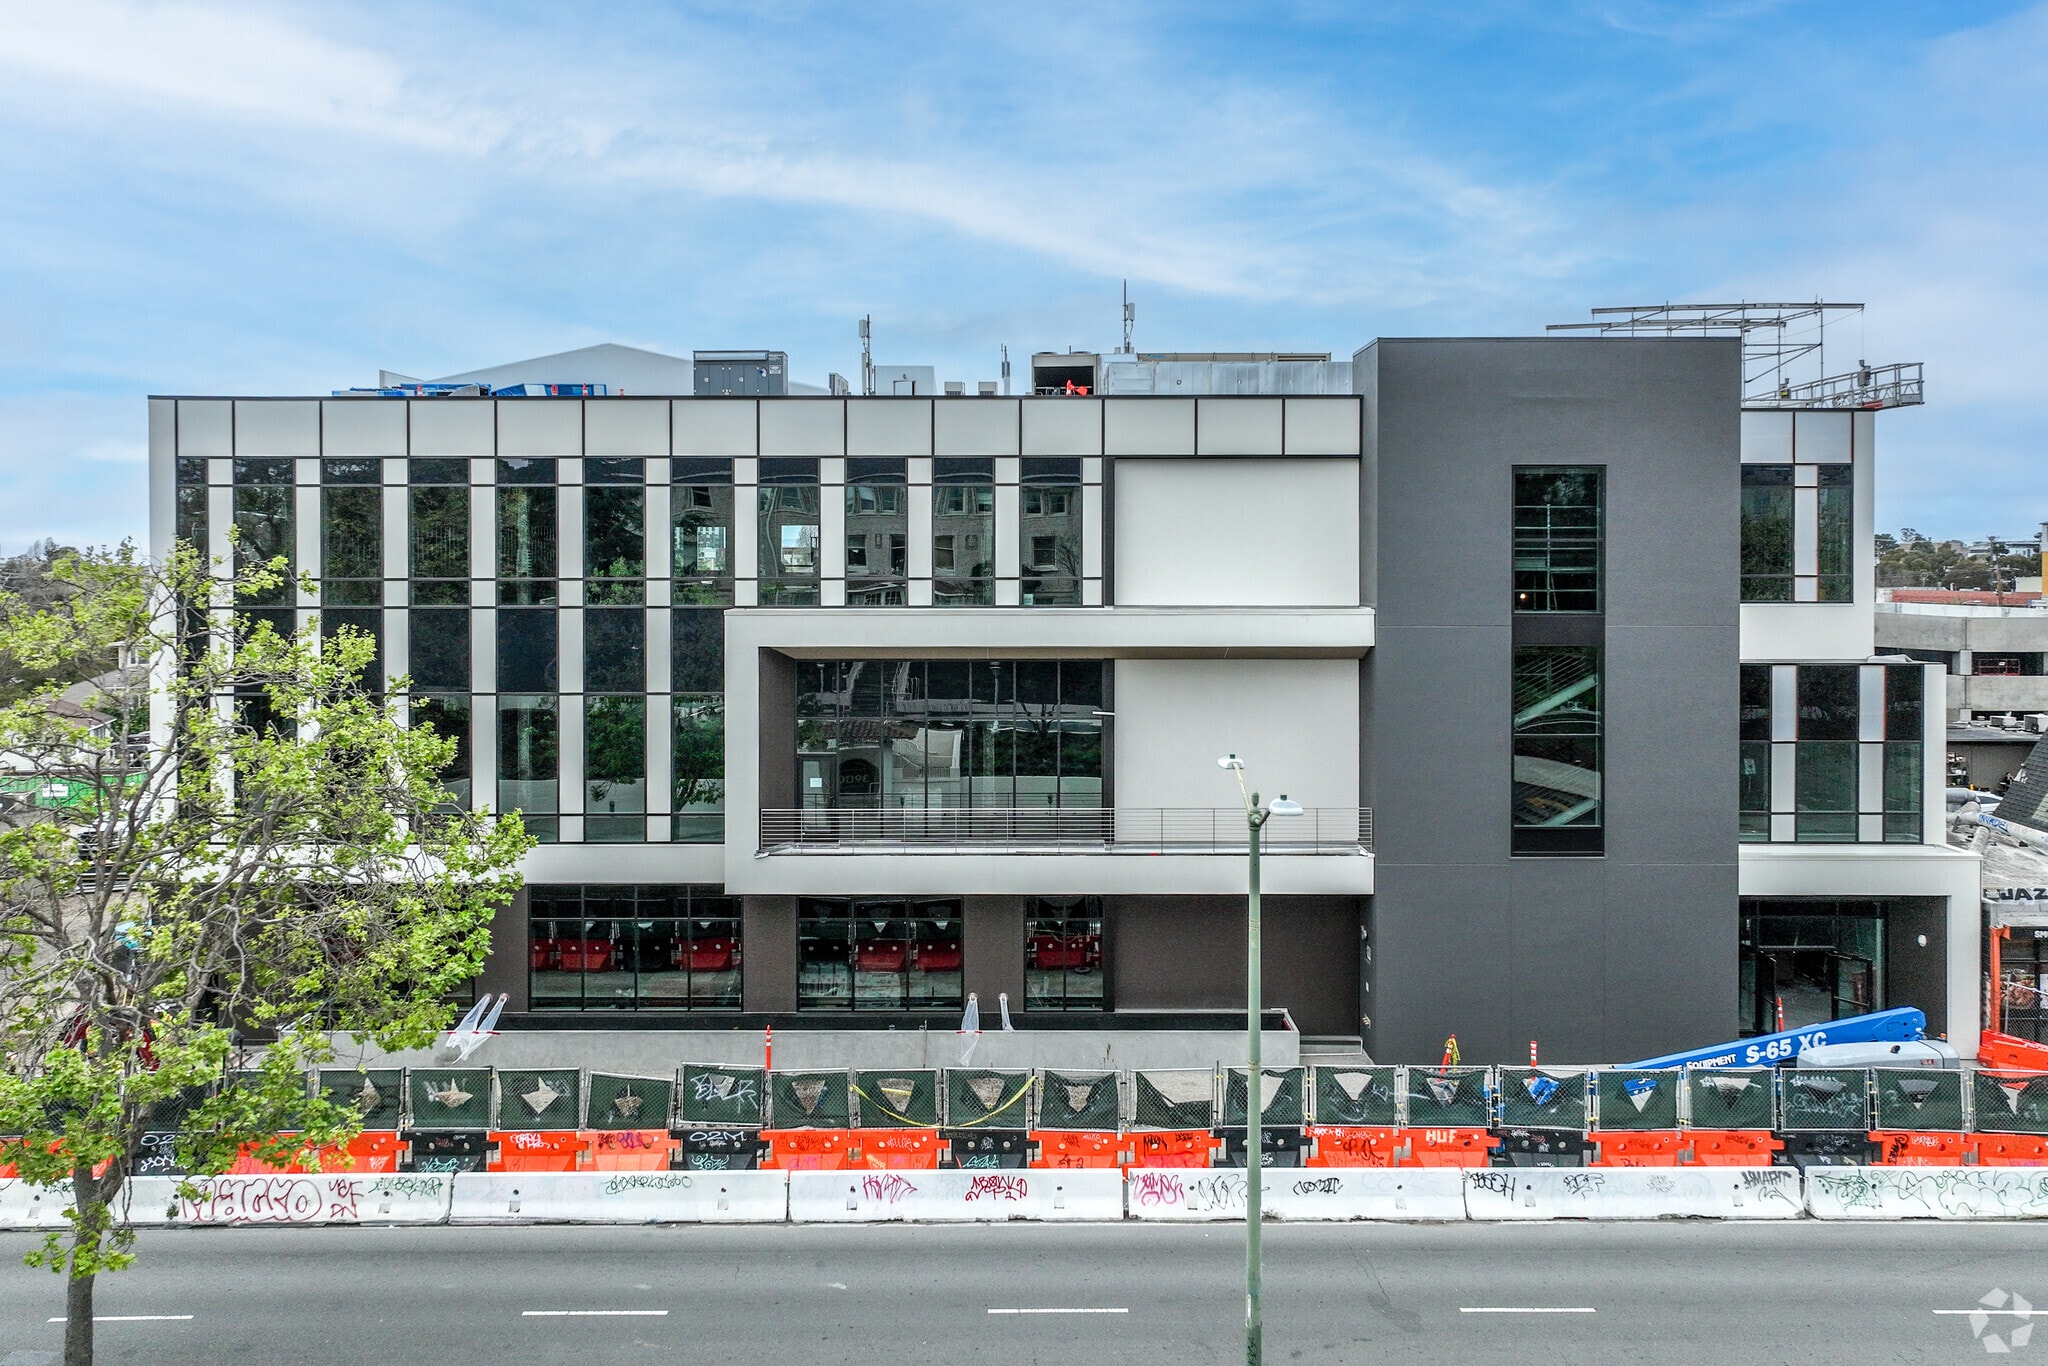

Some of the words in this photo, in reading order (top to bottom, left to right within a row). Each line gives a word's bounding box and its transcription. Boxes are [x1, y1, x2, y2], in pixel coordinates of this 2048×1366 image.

[1746, 1038, 1792, 1064] S-65
[1798, 1032, 1827, 1052] XC
[1686, 1053, 1736, 1069] EQUIPMENT
